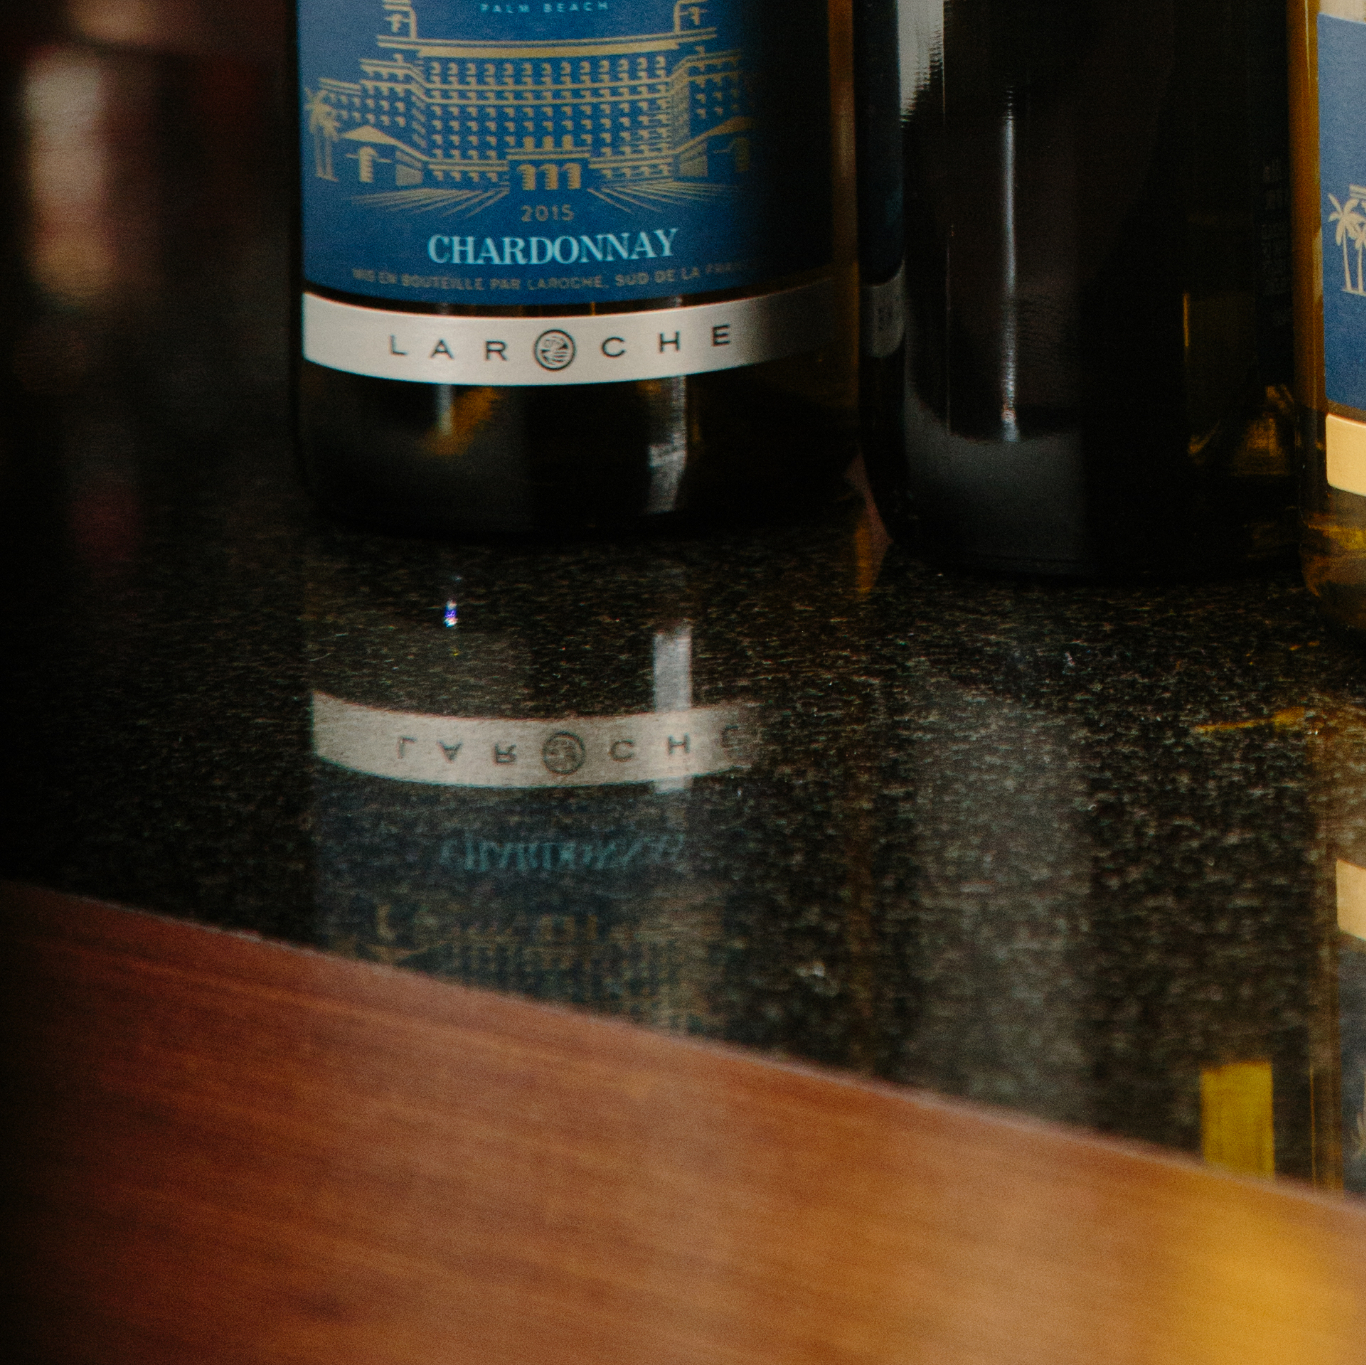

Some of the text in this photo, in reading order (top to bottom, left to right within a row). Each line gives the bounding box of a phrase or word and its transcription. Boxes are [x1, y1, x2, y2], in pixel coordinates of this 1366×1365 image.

[479, 1, 609, 14] PALM BEACH
[520, 204, 575, 223] 2015
[427, 228, 679, 266] CHARDONNAY
[489, 279, 522, 291] PAR
[615, 271, 651, 287] SUD
[655, 269, 676, 284] DE
[681, 266, 701, 281] LA
